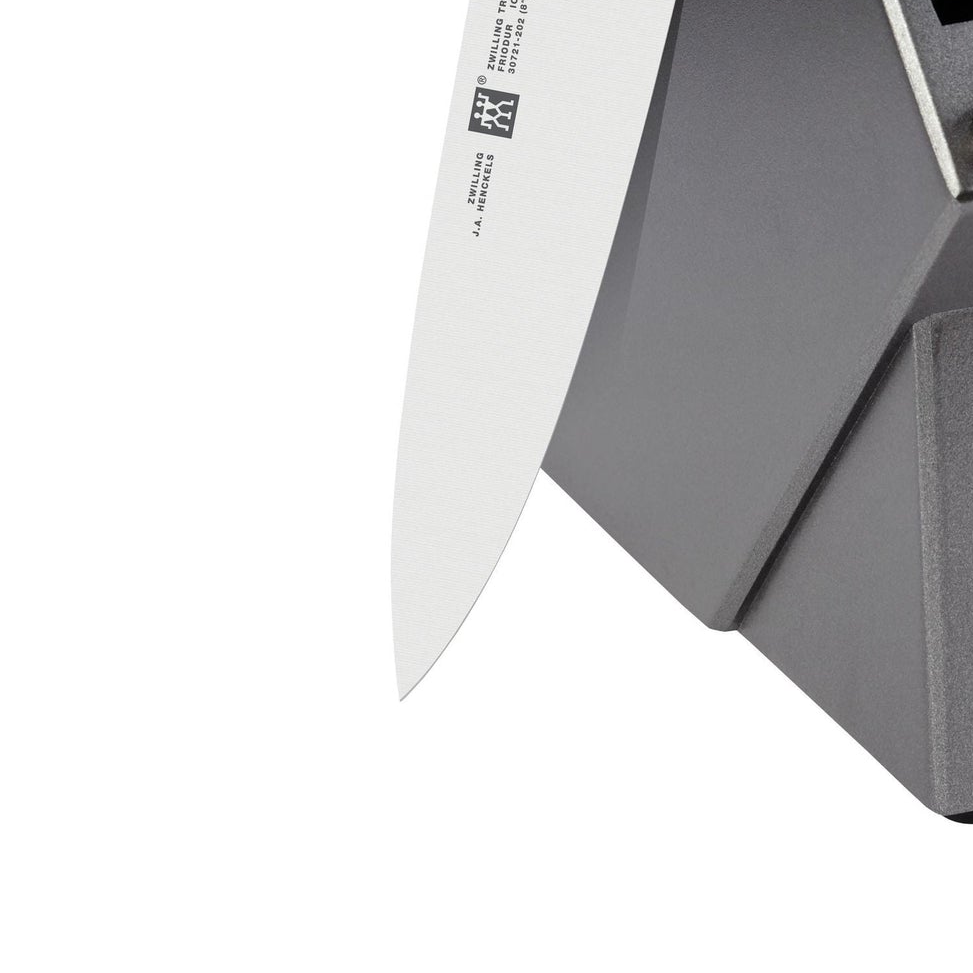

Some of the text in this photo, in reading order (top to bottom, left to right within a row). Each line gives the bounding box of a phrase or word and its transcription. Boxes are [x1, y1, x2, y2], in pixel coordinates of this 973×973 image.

[486, 18, 504, 71] ZWILLING
[497, 24, 514, 73] FRIODUR
[507, 17, 525, 75] 30721-202
[467, 152, 484, 205] ZWILLING
[472, 154, 495, 237] J.A. HENCKELS
